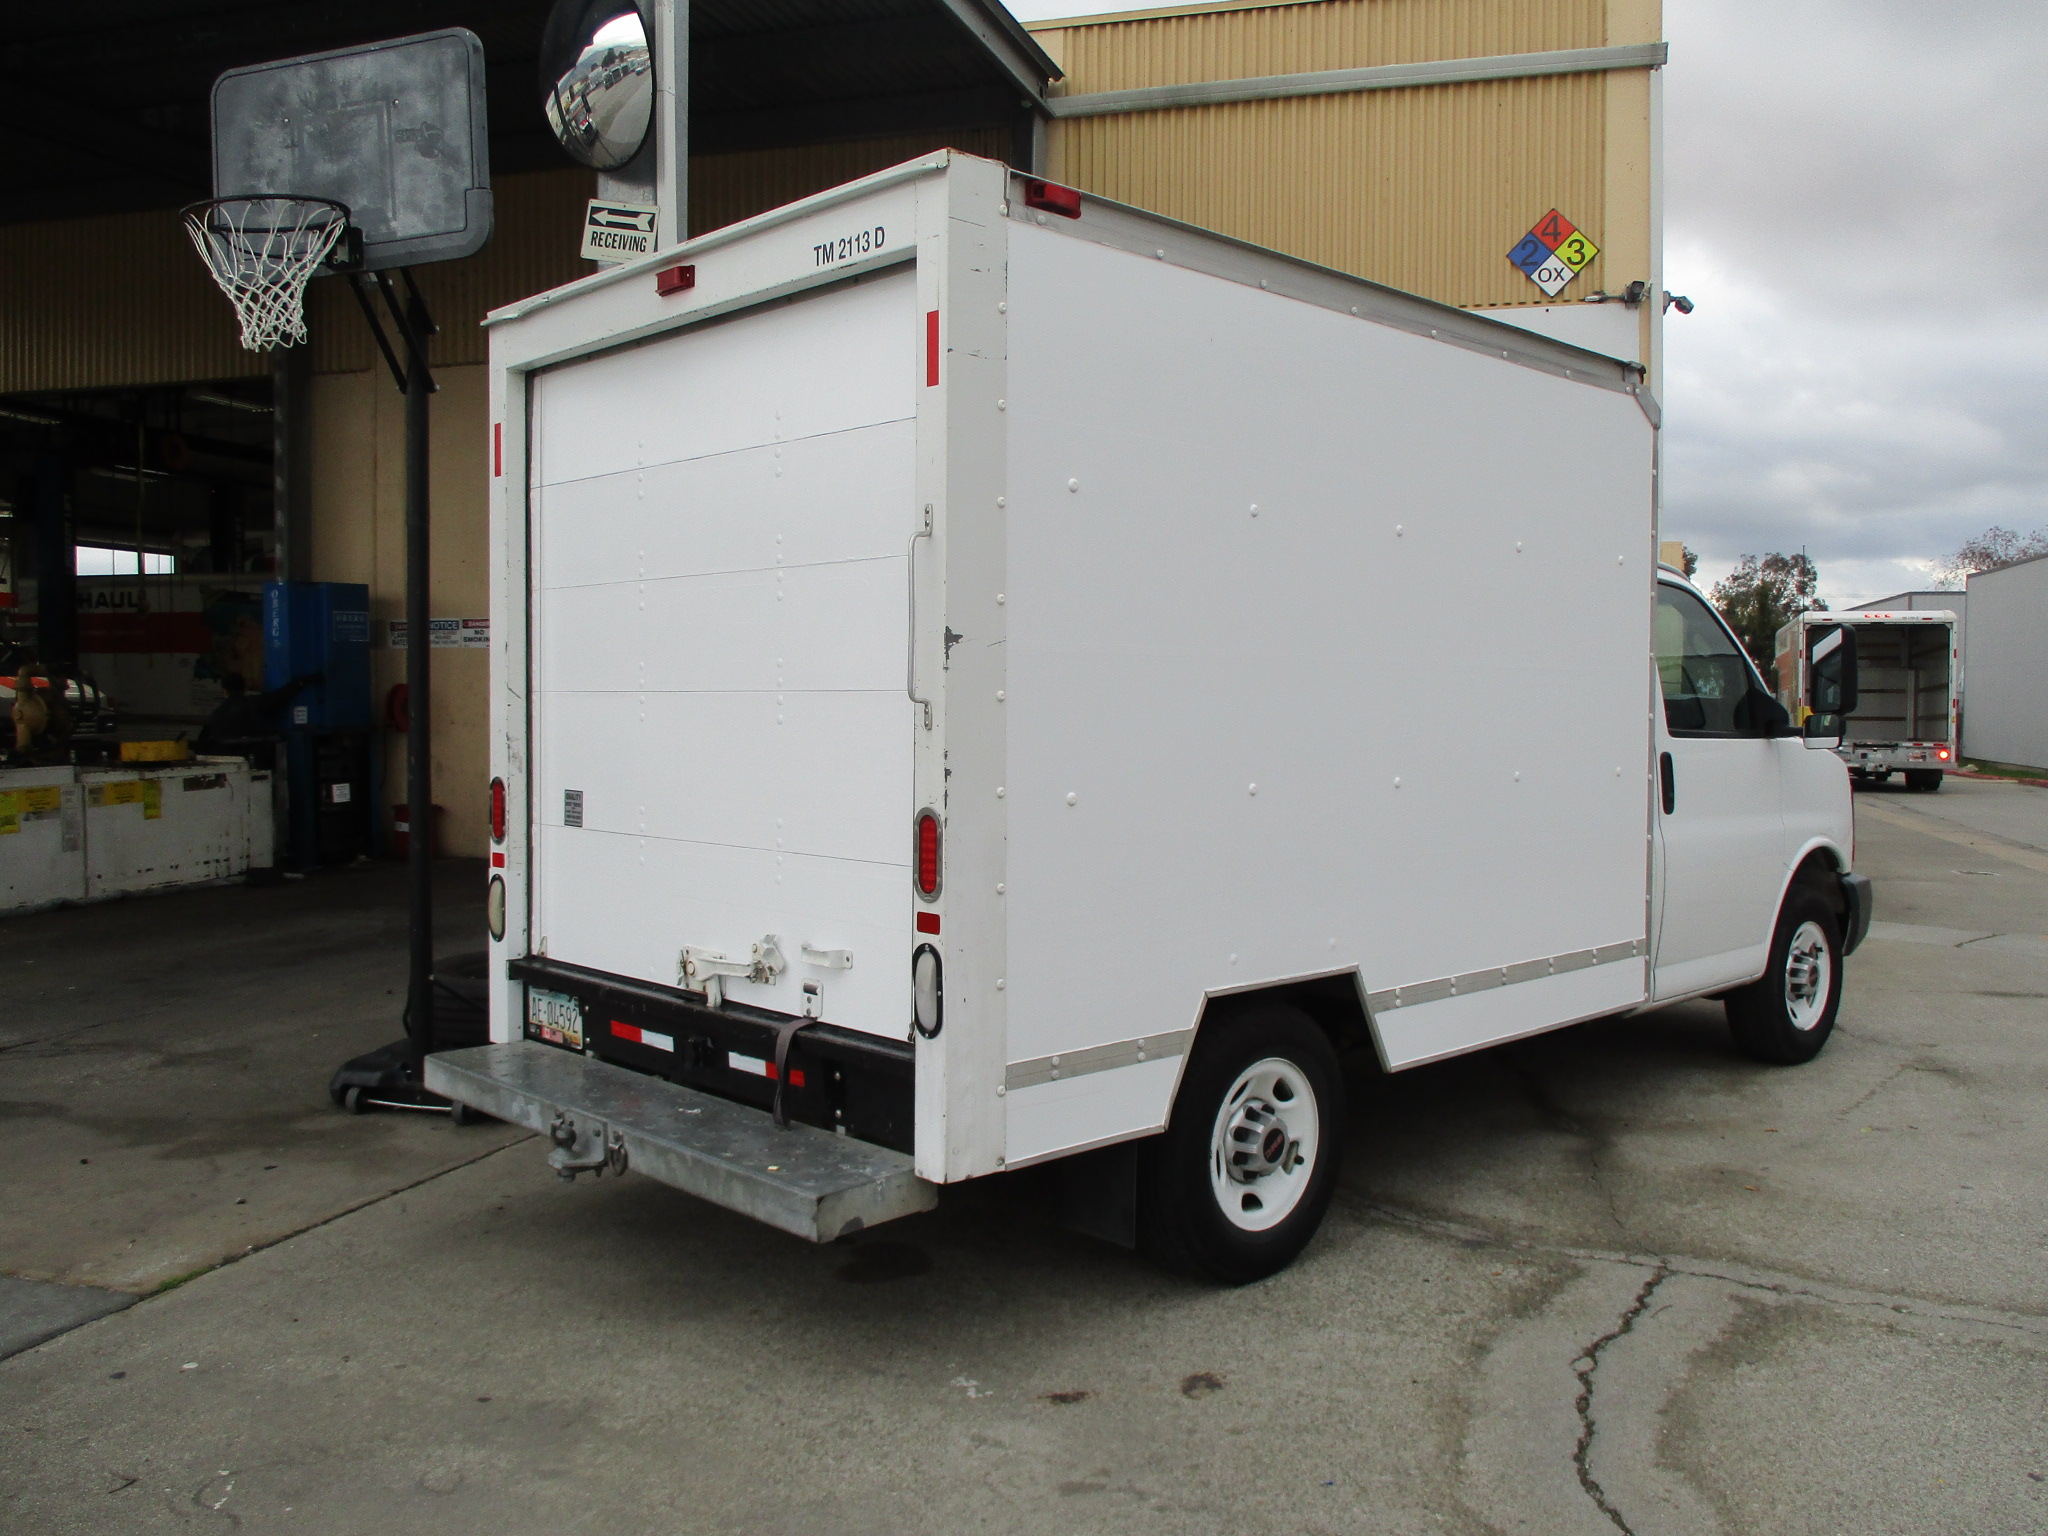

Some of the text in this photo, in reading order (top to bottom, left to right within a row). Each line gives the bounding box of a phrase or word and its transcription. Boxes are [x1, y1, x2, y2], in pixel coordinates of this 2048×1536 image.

[1541, 215, 1562, 242] 4
[590, 230, 647, 253] RECEIVING
[813, 226, 885, 266] TM 2113 D
[1520, 238, 1586, 266] 2 3
[1537, 266, 1566, 283] OX
[429, 621, 458, 630] NOTICE
